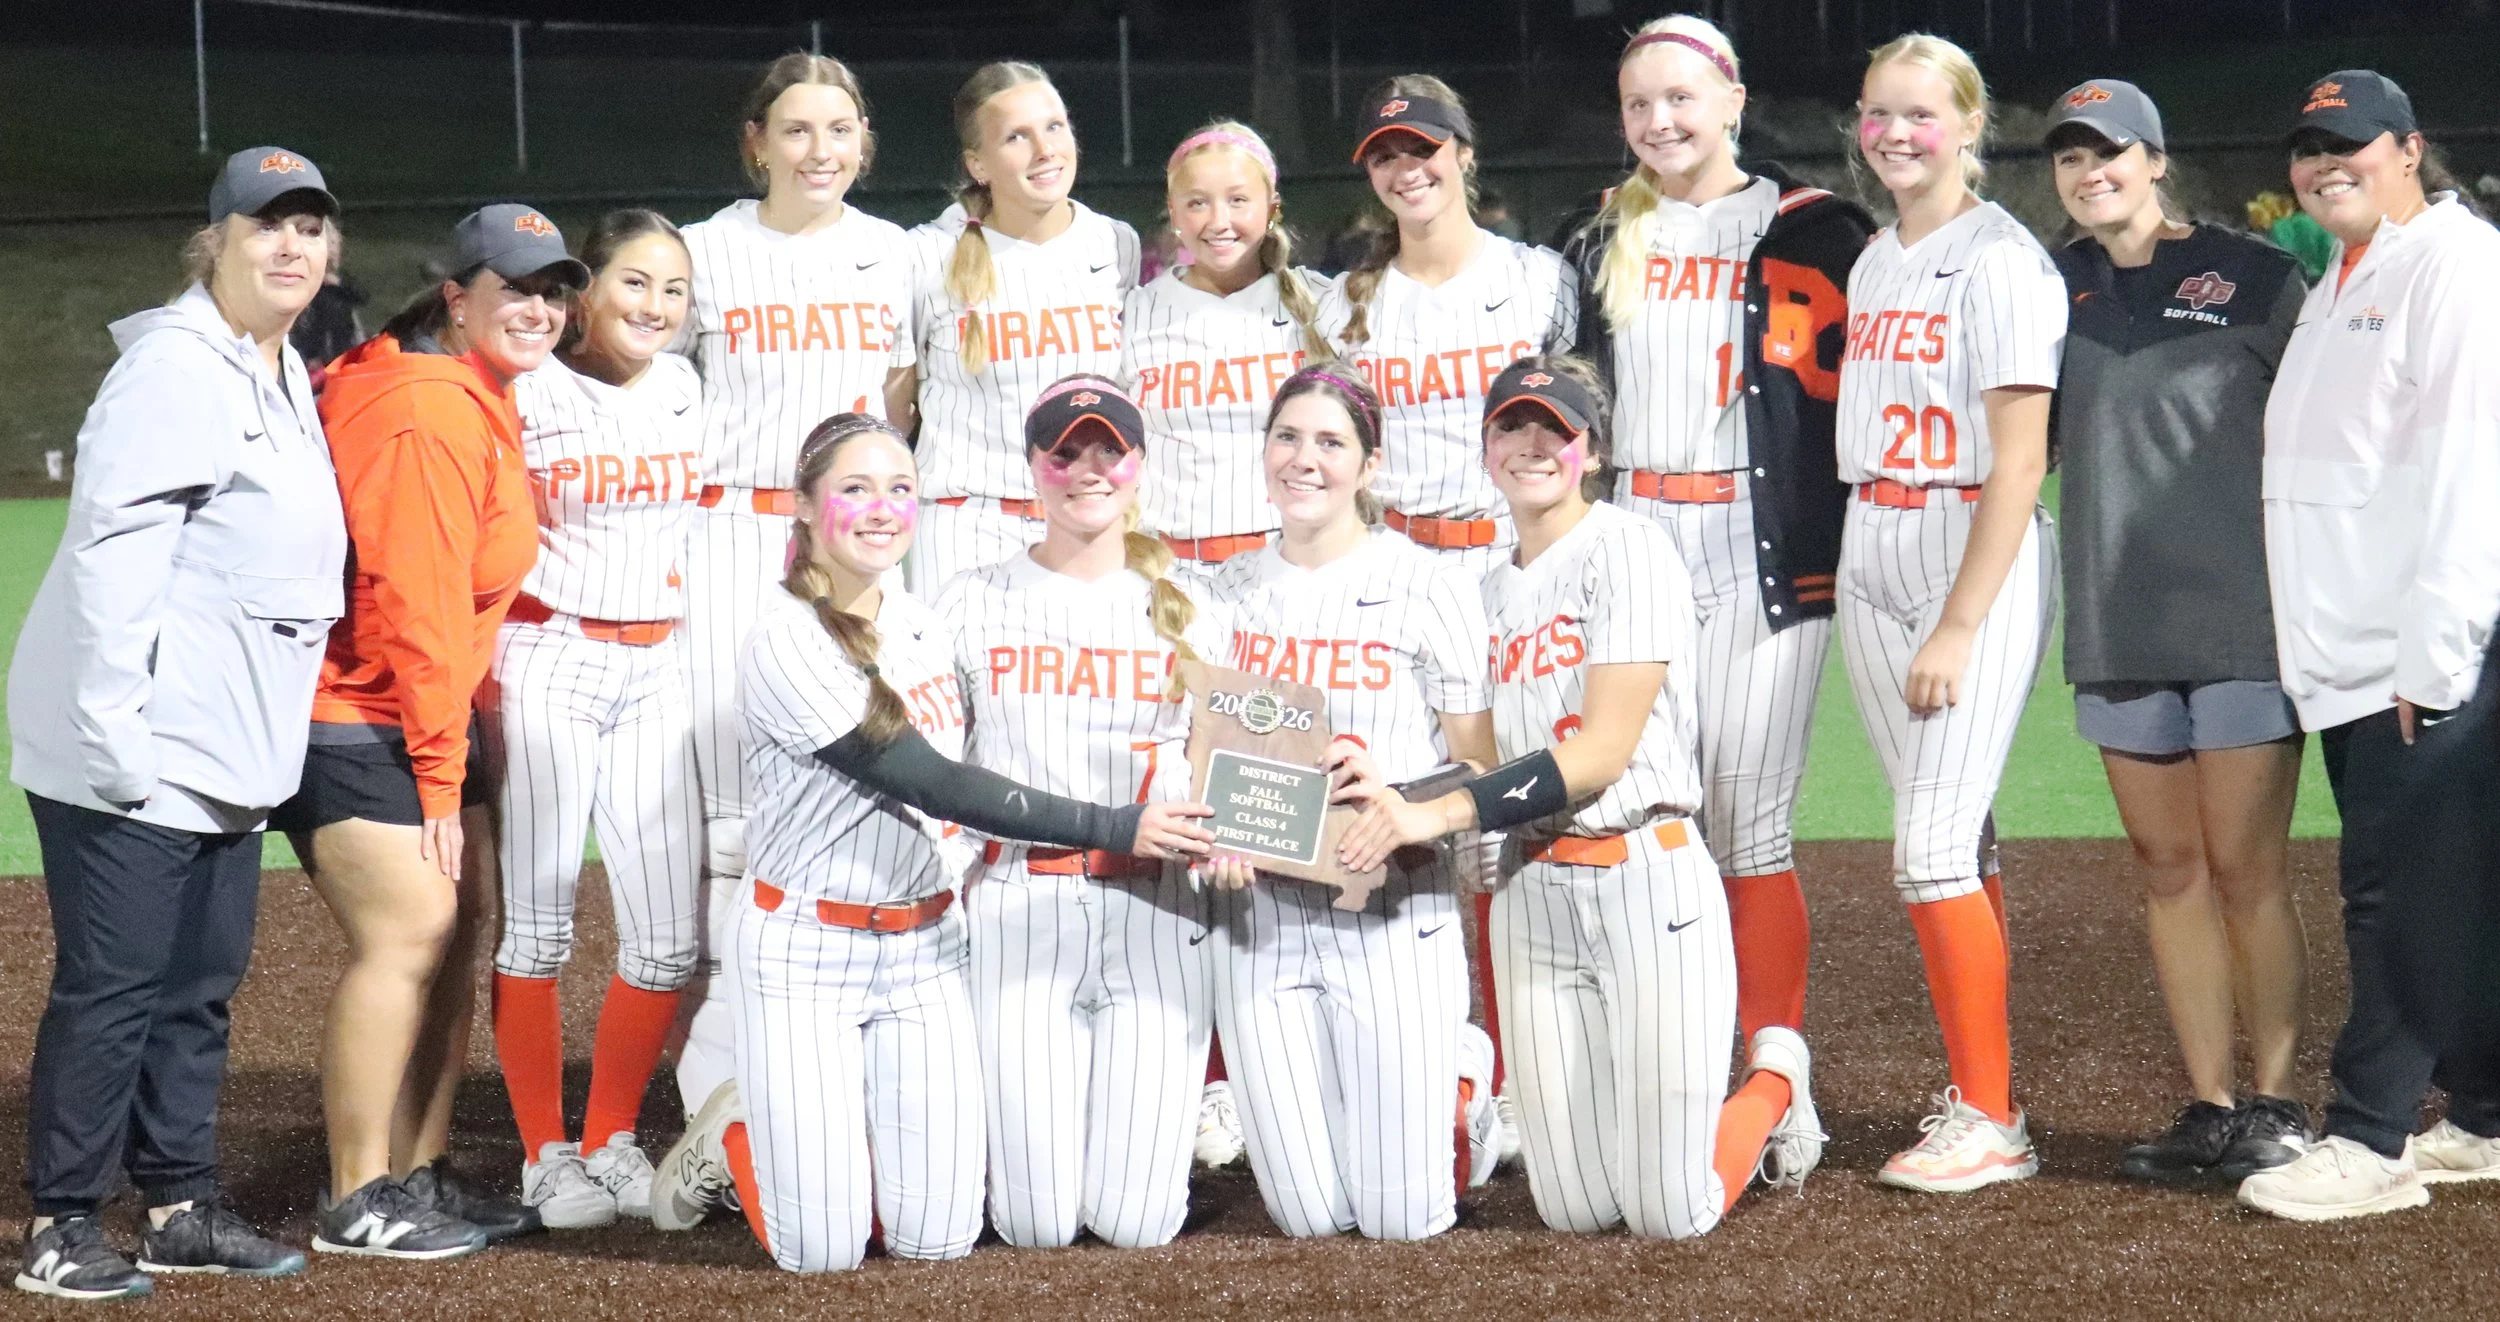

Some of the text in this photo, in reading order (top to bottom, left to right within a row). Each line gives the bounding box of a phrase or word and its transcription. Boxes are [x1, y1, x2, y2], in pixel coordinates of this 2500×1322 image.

[724, 303, 897, 354] PIRATES
[2163, 308, 2228, 326] SOFTBALL
[1716, 342, 1745, 408] 1
[1883, 404, 1957, 469] 20
[549, 451, 703, 504] PIRATE
[1208, 691, 1239, 715] 20
[1282, 707, 1313, 731] 26
[1130, 741, 1158, 804] 7
[1239, 765, 1302, 788] DISTRICT
[1229, 792, 1298, 816] SOFTBALL
[1249, 785, 1283, 801] FALL
[1235, 812, 1287, 831] CLASS 4
[1216, 826, 1300, 852] FIRST PLACE
